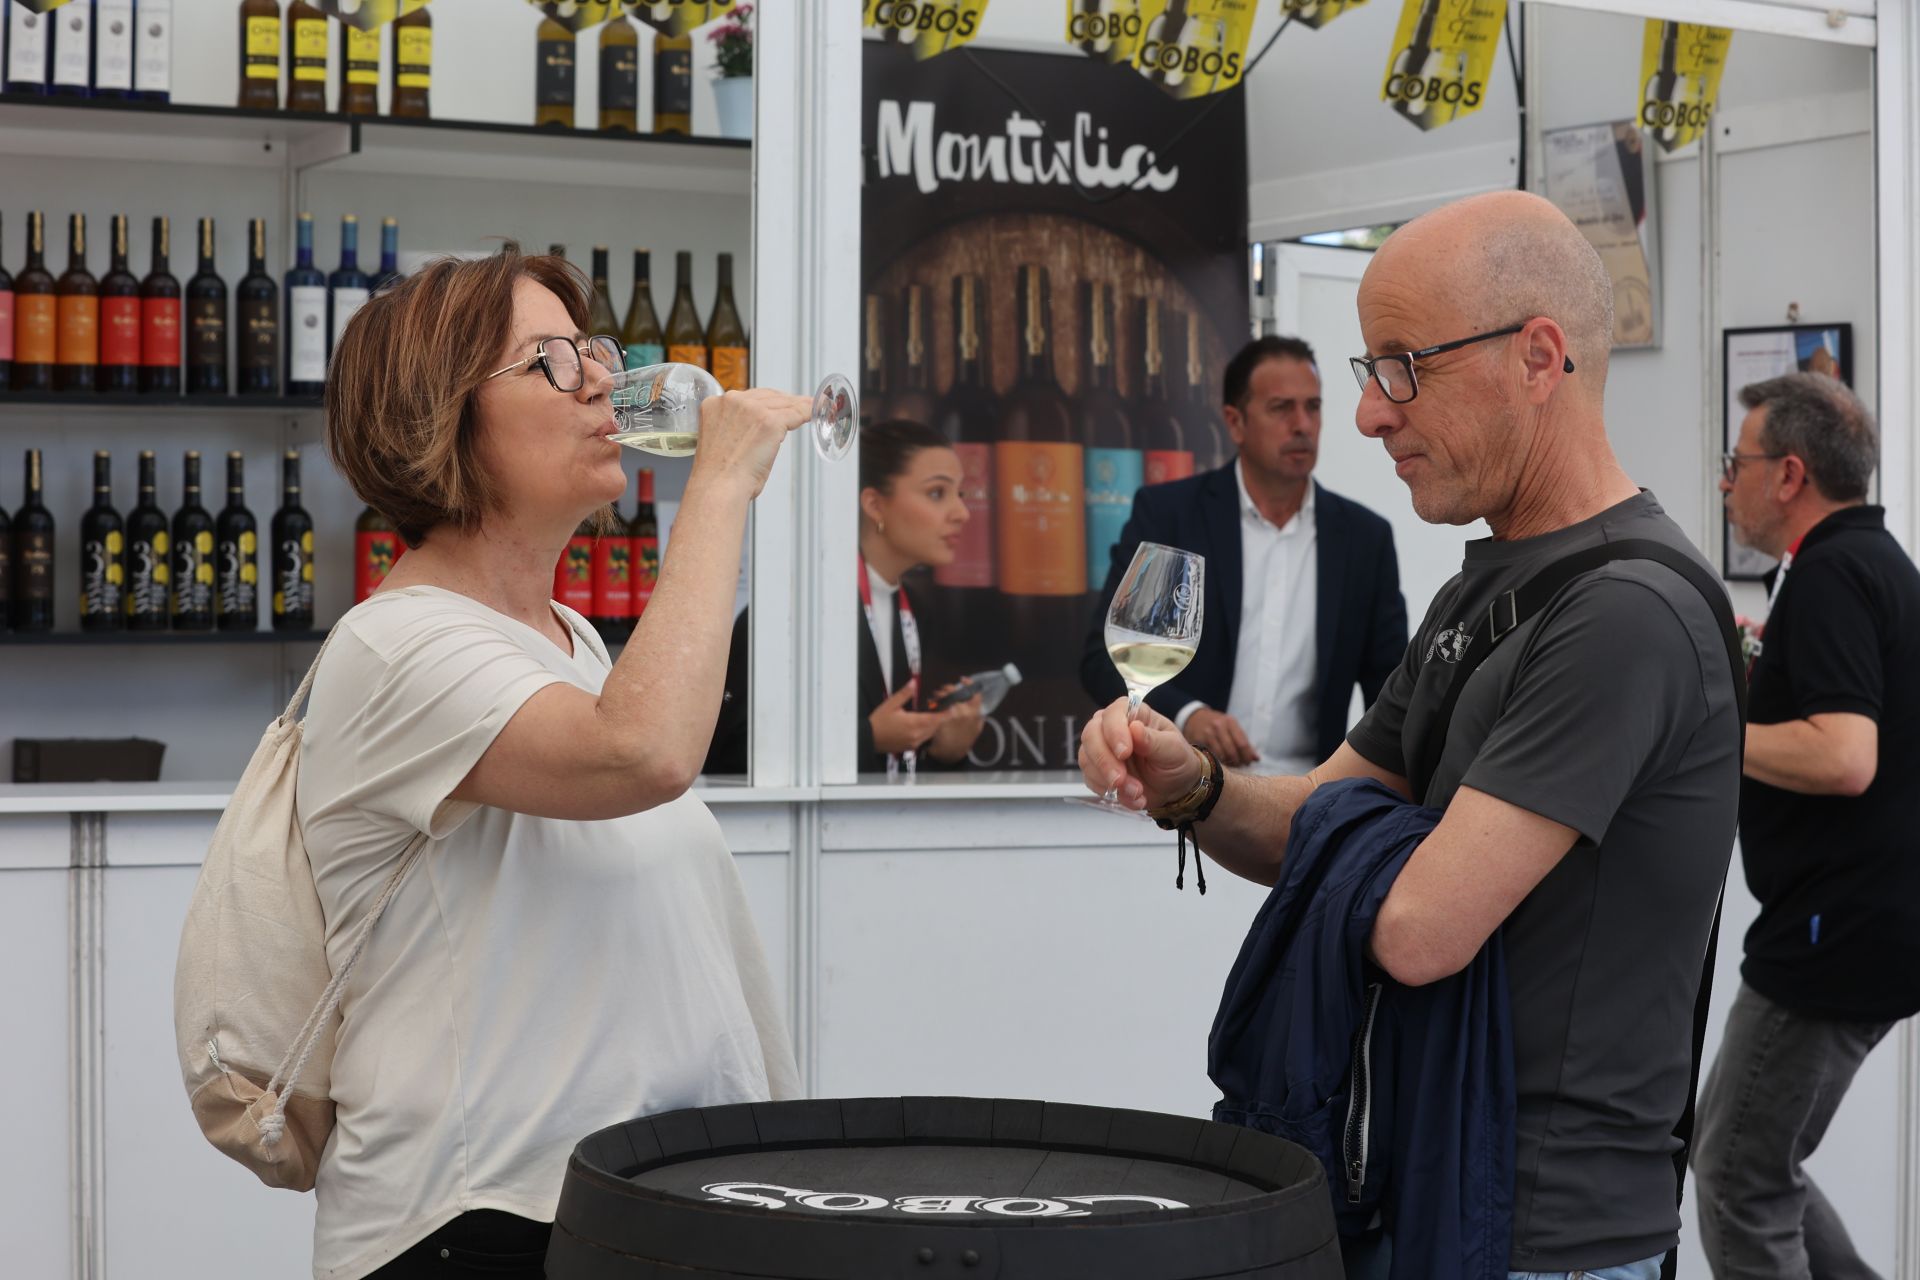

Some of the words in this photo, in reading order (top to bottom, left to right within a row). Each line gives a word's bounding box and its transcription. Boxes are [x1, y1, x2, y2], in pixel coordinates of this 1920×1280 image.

[875, 0, 977, 36] COBOS
[1070, 13, 1141, 40] COBO
[1140, 41, 1240, 80] COBOS
[1385, 74, 1482, 107] COBOS
[1641, 101, 1712, 128] COBOS
[877, 99, 1180, 194] Montulia
[701, 1182, 1190, 1217] COBOS
